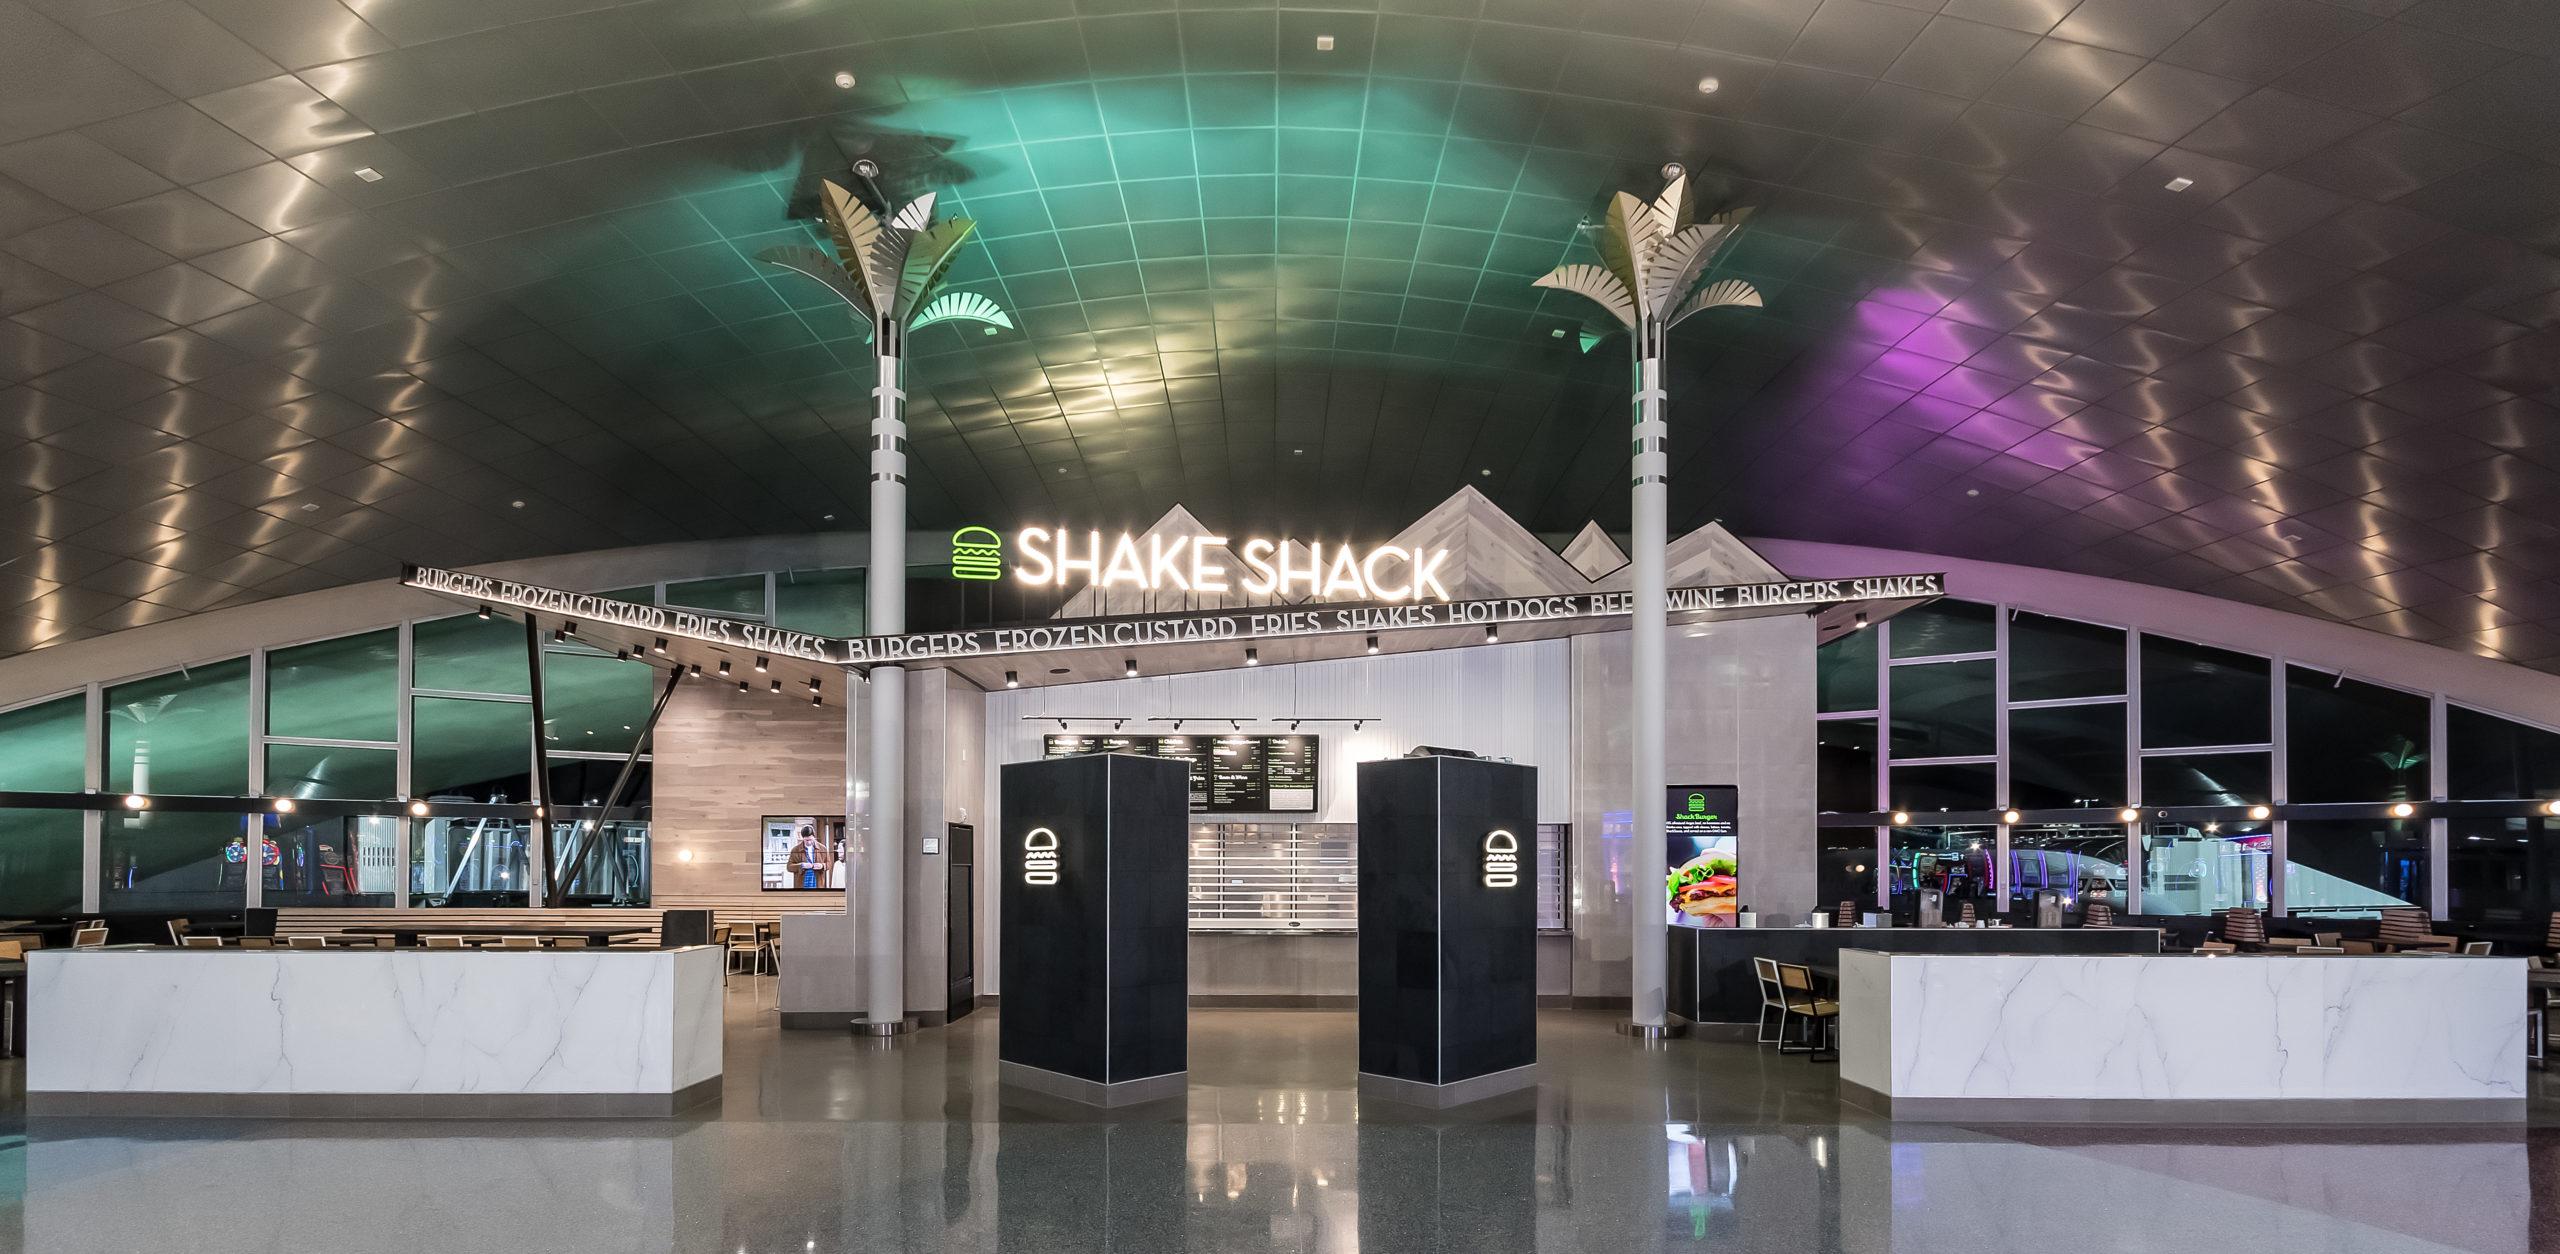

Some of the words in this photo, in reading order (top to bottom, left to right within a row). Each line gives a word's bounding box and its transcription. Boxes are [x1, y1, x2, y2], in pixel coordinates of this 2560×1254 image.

[1015, 527, 1229, 592] SHAKE
[1241, 538, 1451, 602] SHACK
[417, 567, 493, 598] BURGERS
[500, 581, 574, 613] FROZEN
[577, 597, 665, 630] CUSTARD
[675, 613, 730, 642] FRIES
[742, 625, 825, 660] SHAKES
[848, 631, 981, 661] BURGERS
[995, 624, 1106, 651] FROZEN
[1113, 616, 1237, 645] CUSTARD
[1251, 611, 1322, 636] FRIES
[1336, 604, 1436, 631] SHAKES
[1448, 600, 1501, 624] HOT
[1507, 596, 1578, 620] DOGS
[1590, 593, 1633, 616] BEE
[1666, 588, 1725, 611] WINE
[1737, 580, 1841, 606] BURGERS
[1853, 575, 1938, 600] SHAKES
